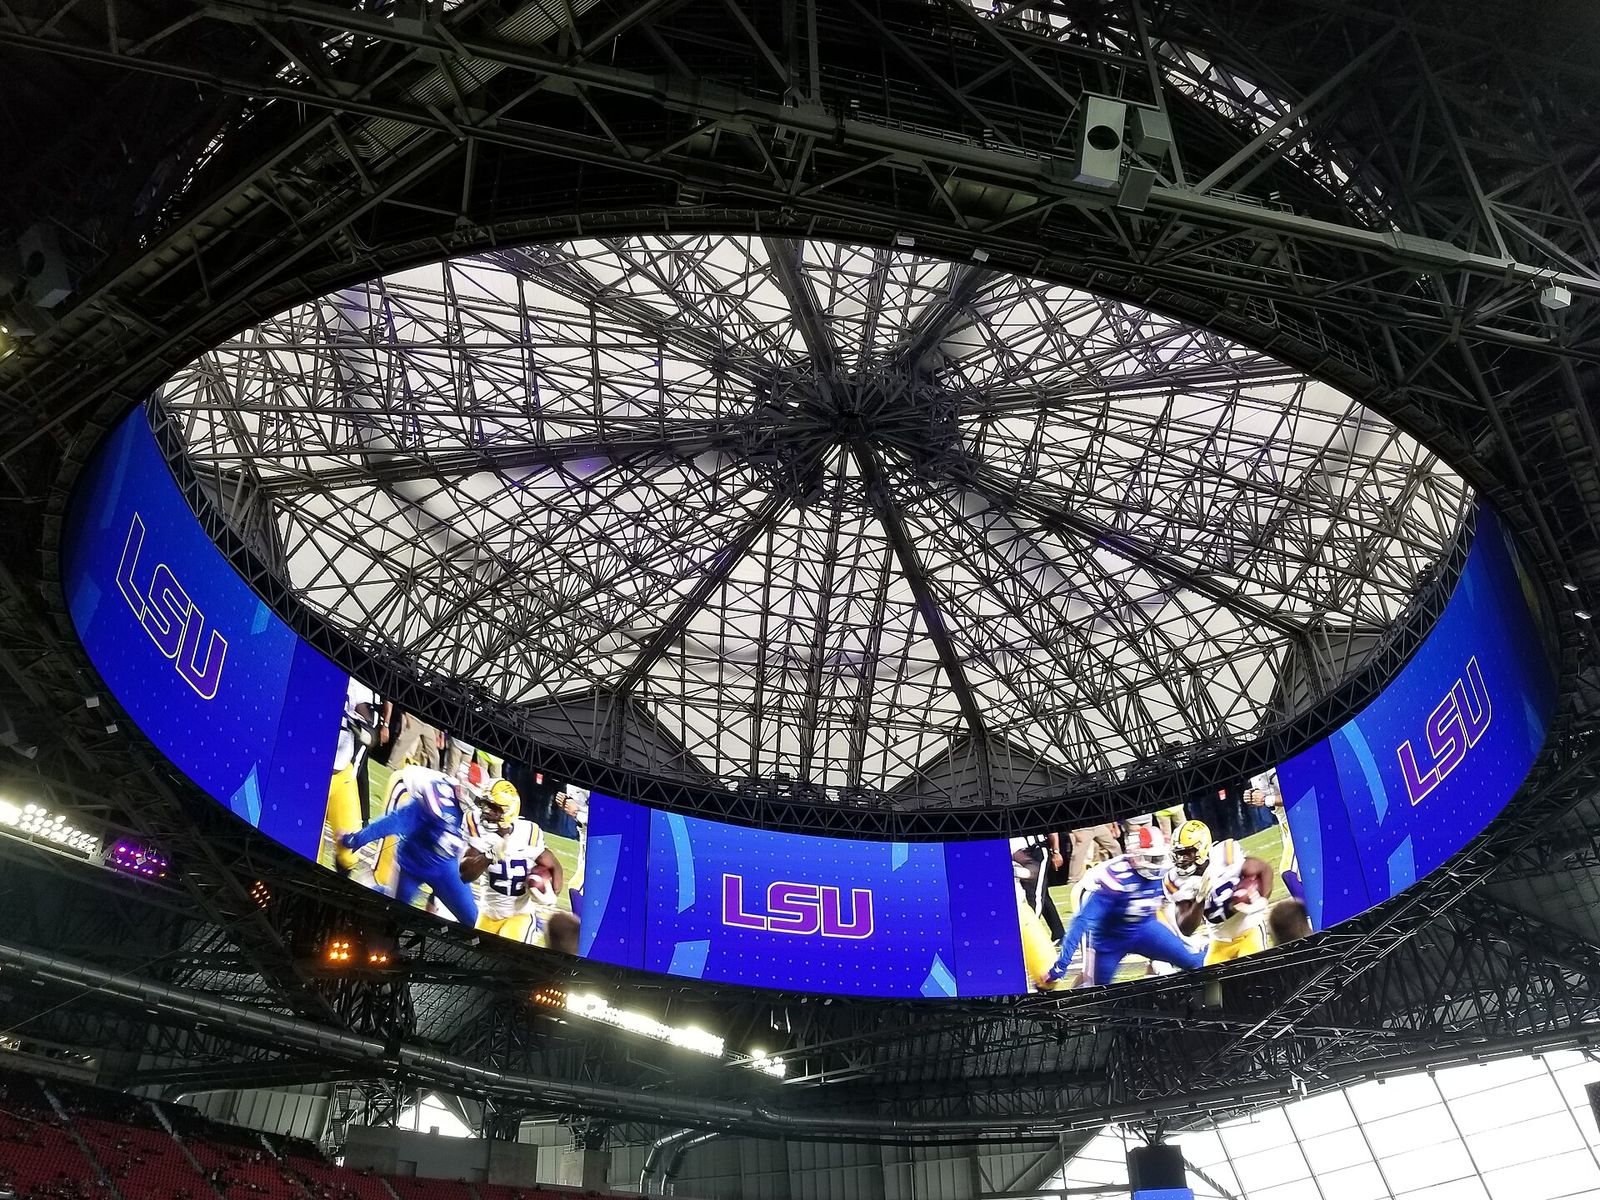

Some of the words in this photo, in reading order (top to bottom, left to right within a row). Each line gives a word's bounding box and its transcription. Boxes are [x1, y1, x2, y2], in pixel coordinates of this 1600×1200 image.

[116, 511, 228, 700] LSU
[1396, 655, 1492, 806] LSU
[489, 859, 528, 896] 22
[723, 873, 874, 939] LSU
